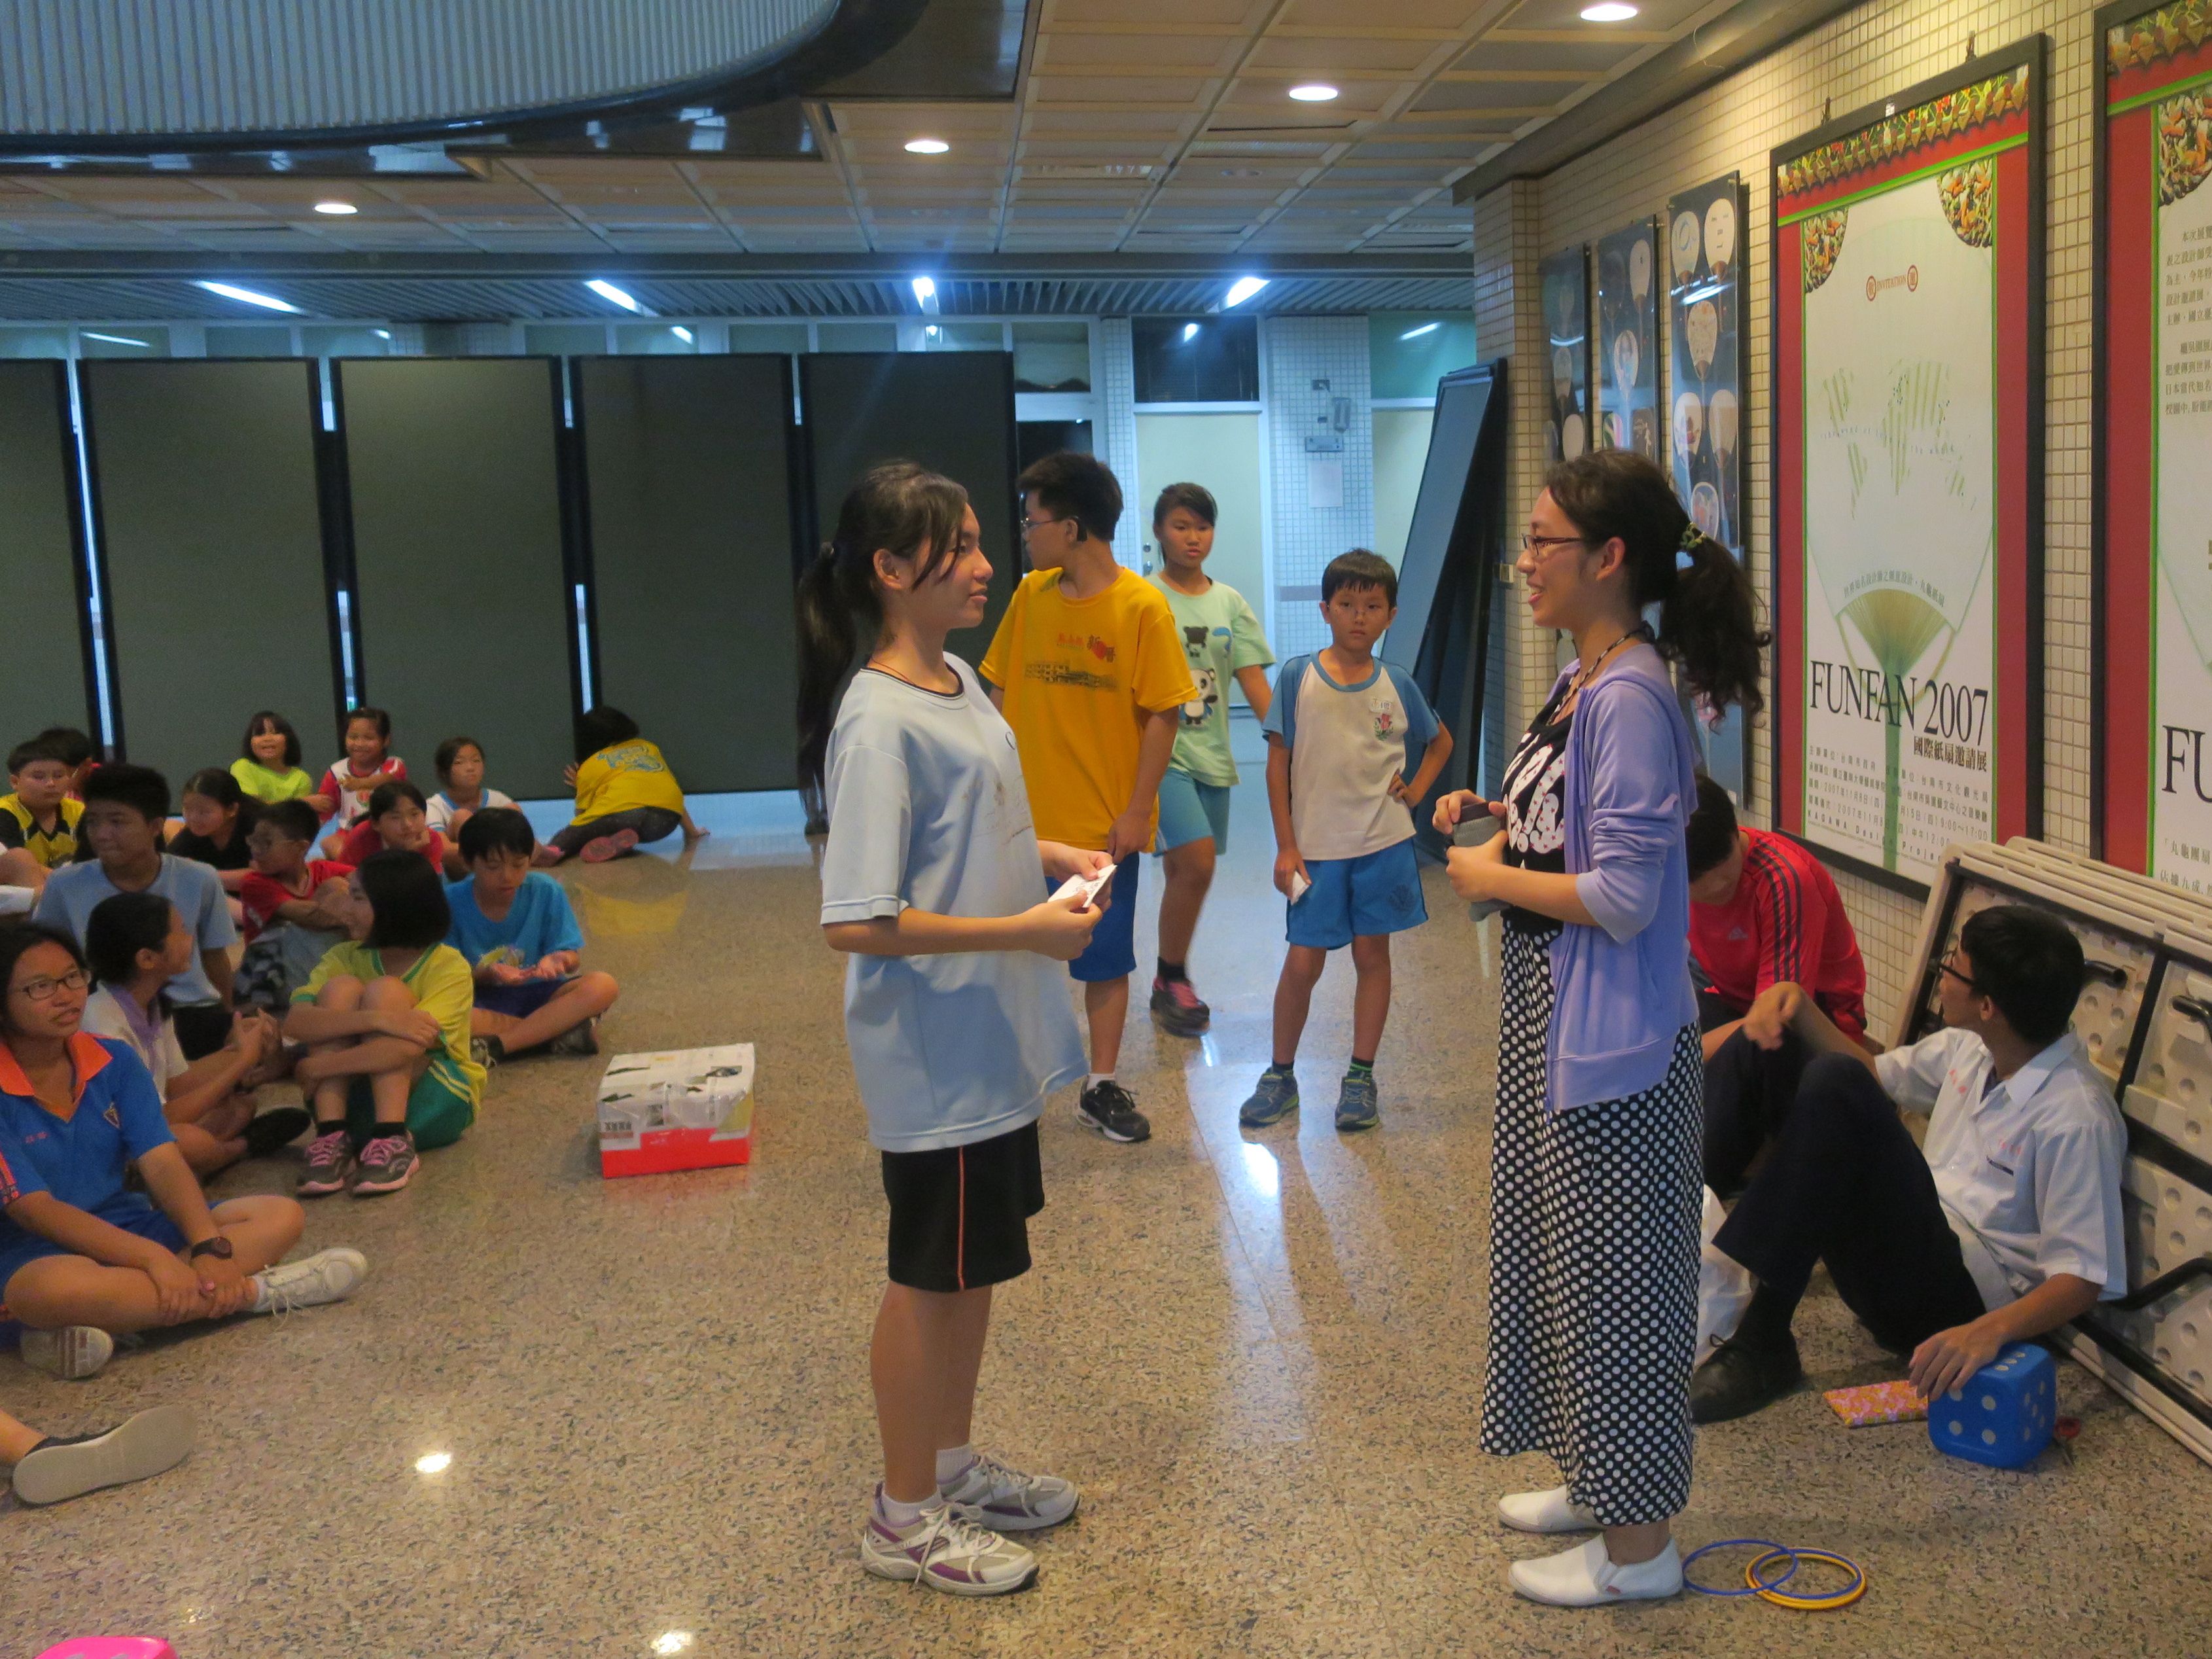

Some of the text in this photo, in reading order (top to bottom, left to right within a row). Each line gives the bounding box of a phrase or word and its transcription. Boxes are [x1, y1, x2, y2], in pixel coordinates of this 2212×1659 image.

[1877, 274, 1907, 291] INVITATION
[1810, 660, 1989, 746] FUNFAN 2007
[1913, 736, 1988, 773] 國際紙扇邀請展
